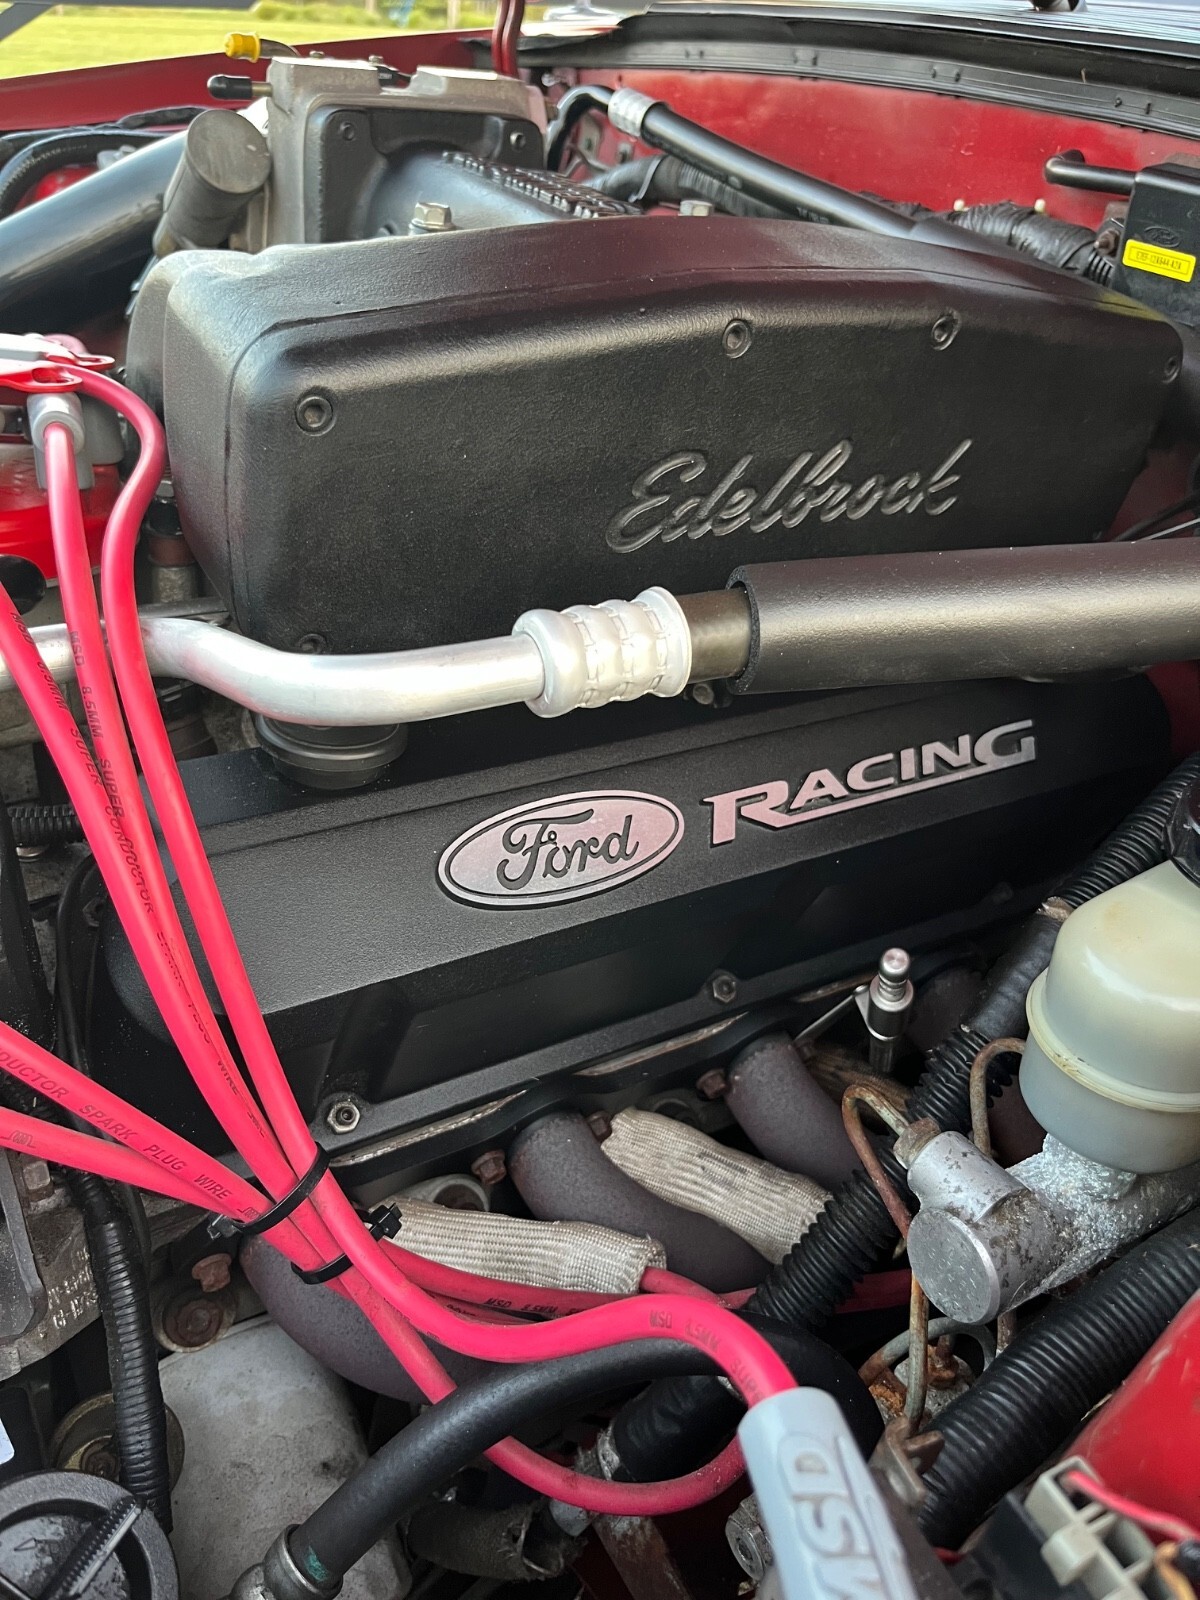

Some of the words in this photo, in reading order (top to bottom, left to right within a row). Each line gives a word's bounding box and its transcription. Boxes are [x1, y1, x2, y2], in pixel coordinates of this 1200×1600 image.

[605, 438, 972, 554] Edelbrock
[70, 631, 85, 666] MSD
[82, 686, 103, 738] 8.5MM
[101, 758, 125, 818] SUPER
[71, 728, 103, 786] SUPER
[496, 808, 640, 890] Ford
[703, 719, 1035, 846] RACING
[80, 1104, 138, 1140] SPARK
[143, 1144, 188, 1171] PLUG
[193, 1174, 233, 1200] WIRE
